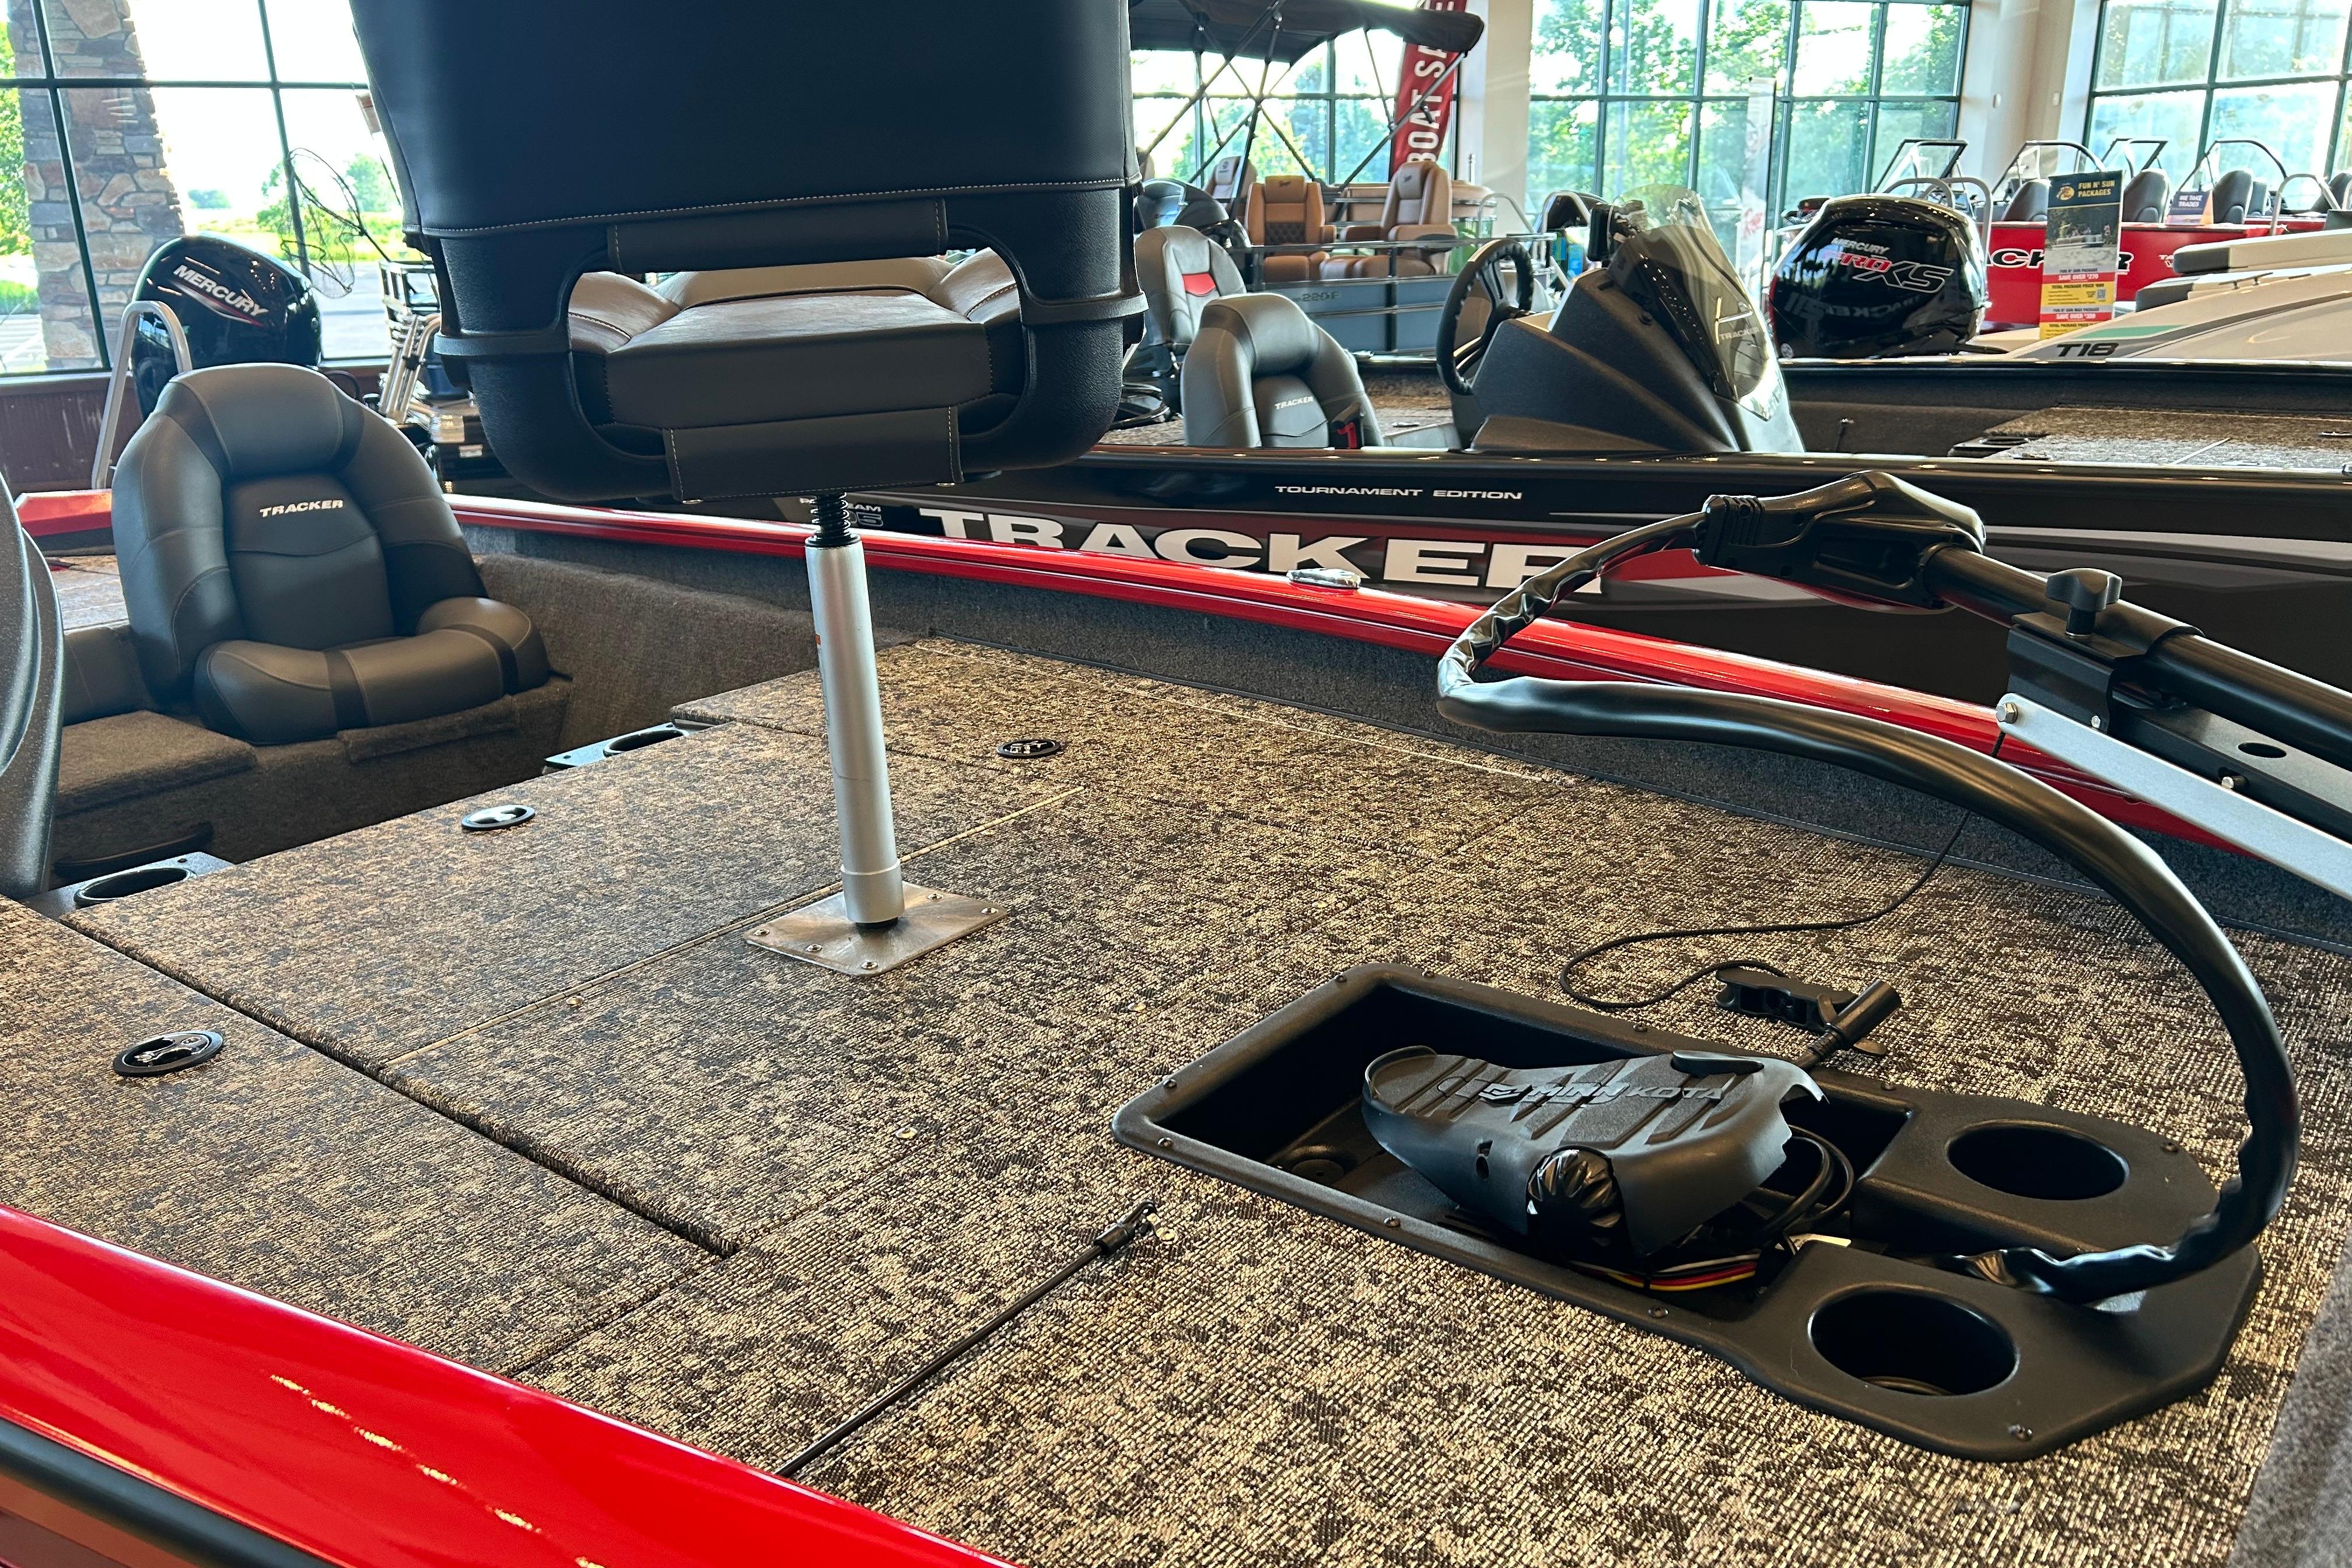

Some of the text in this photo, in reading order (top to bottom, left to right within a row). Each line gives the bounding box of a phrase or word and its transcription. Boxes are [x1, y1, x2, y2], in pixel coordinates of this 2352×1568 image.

[1406, 89, 1443, 163] BOAT
[2078, 188, 2112, 198] PACKAGES
[1831, 237, 1890, 255] MERCURY
[1852, 260, 1955, 293] XS
[173, 264, 270, 316] MERCURY
[2057, 342, 2119, 356] T18
[1274, 396, 1314, 410] TRACKER
[1275, 486, 1522, 499] TOURNAMENT EDITION
[260, 500, 343, 517] TRACKER
[919, 508, 1603, 594] TRACKER
[1528, 1083, 1723, 1101] MINN KOTA
